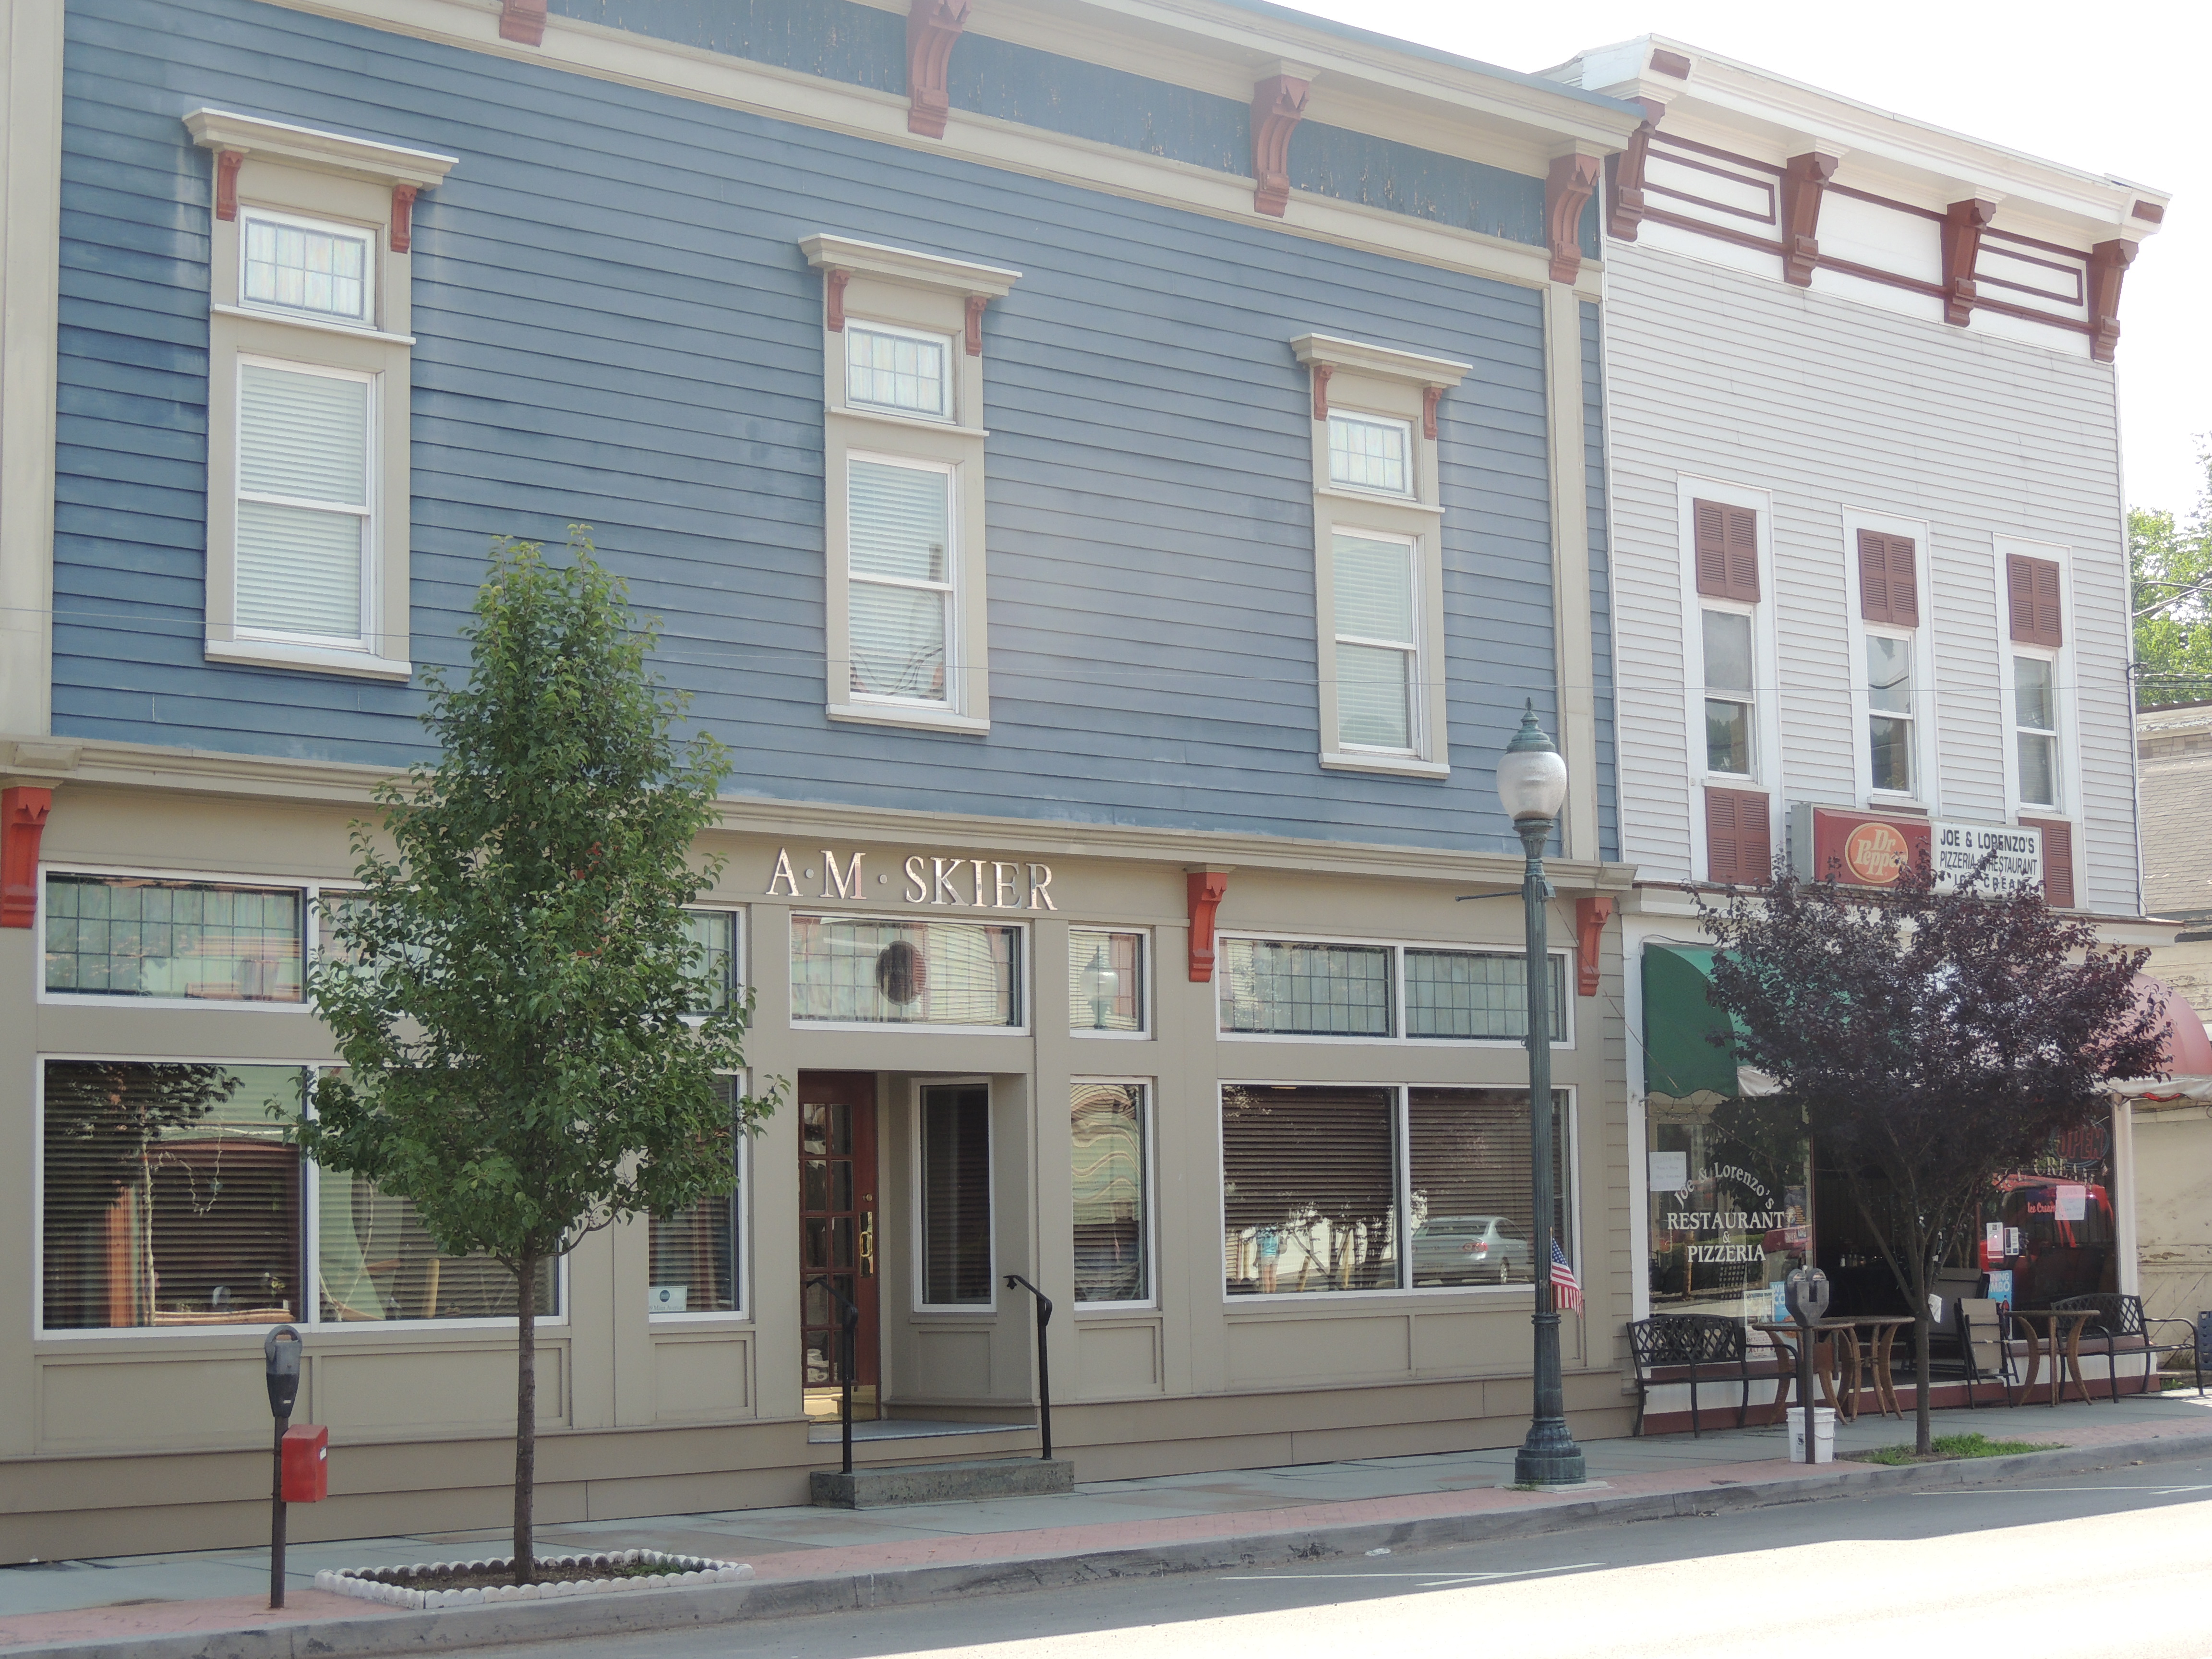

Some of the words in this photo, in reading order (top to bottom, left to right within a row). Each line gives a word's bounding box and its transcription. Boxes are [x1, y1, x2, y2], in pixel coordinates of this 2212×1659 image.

[1871, 829, 1896, 852] Dr
[1940, 829, 1960, 847] JOE
[1965, 831, 1972, 848] &
[1978, 832, 2035, 854] LORENZO'S
[1940, 851, 1974, 869] PIZZERIA
[1988, 855, 2037, 876] RESTAURANT
[905, 855, 1058, 911] SKIER
[1954, 874, 1973, 886] IC
[2056, 1125, 2104, 1160] OPEN
[1674, 1179, 1695, 1210] Joe
[1698, 1166, 1710, 1184] &
[1713, 1162, 1775, 1210] Lorenzo's
[1667, 1211, 1785, 1230] RESTAURANT
[1722, 1230, 1731, 1243] &
[1687, 1243, 1767, 1263] PIZZERIA
[1989, 1281, 2010, 1292] MBO
[1990, 1272, 2010, 1281] NING
